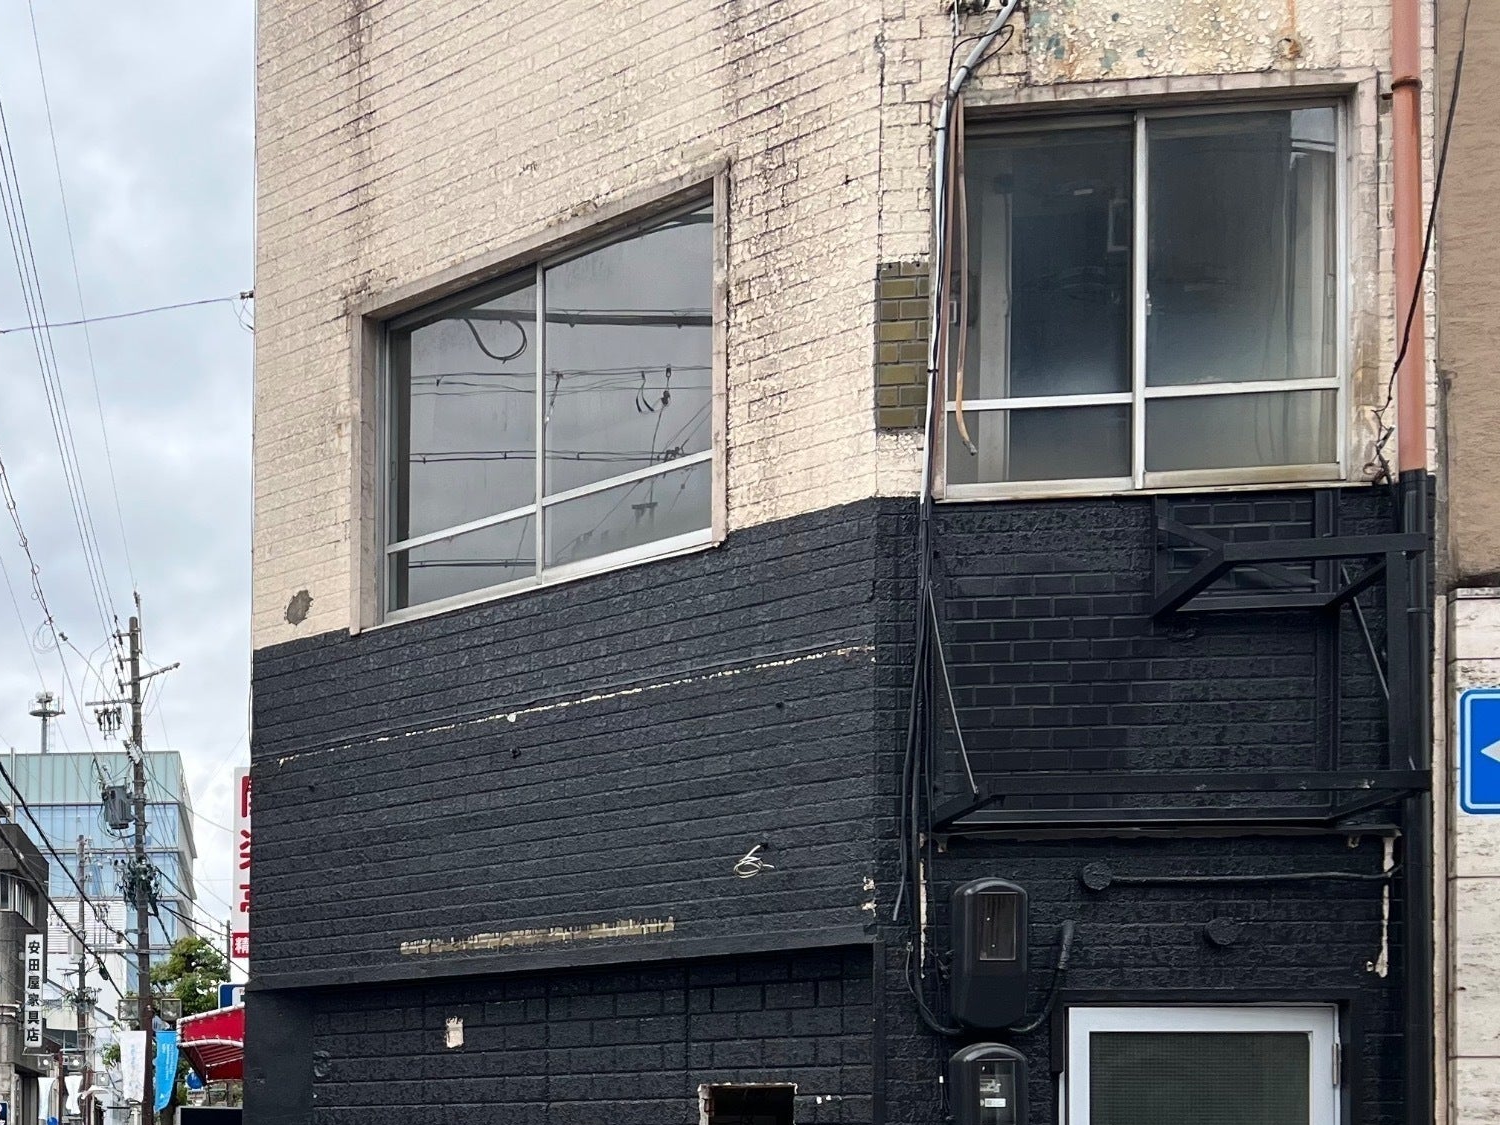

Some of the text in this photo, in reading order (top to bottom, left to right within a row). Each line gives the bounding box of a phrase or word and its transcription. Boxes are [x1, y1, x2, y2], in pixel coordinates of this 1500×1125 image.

[27, 940, 41, 1042] 安田屋家具店
